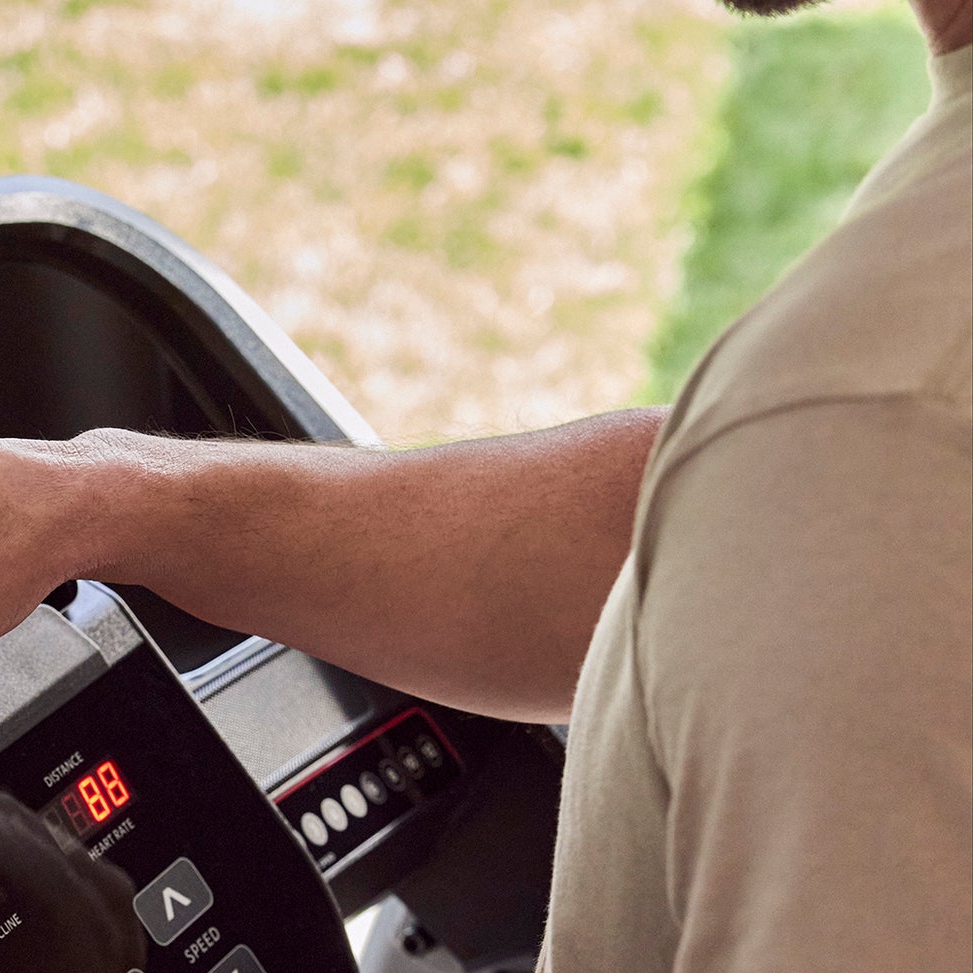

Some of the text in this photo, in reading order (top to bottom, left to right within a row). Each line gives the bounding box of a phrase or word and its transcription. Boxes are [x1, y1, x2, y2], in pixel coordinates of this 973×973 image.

[43, 751, 84, 788] DISTANCE
[78, 761, 129, 822] 88
[87, 818, 136, 861] HEART RATE
[184, 927, 221, 965] SPEED
